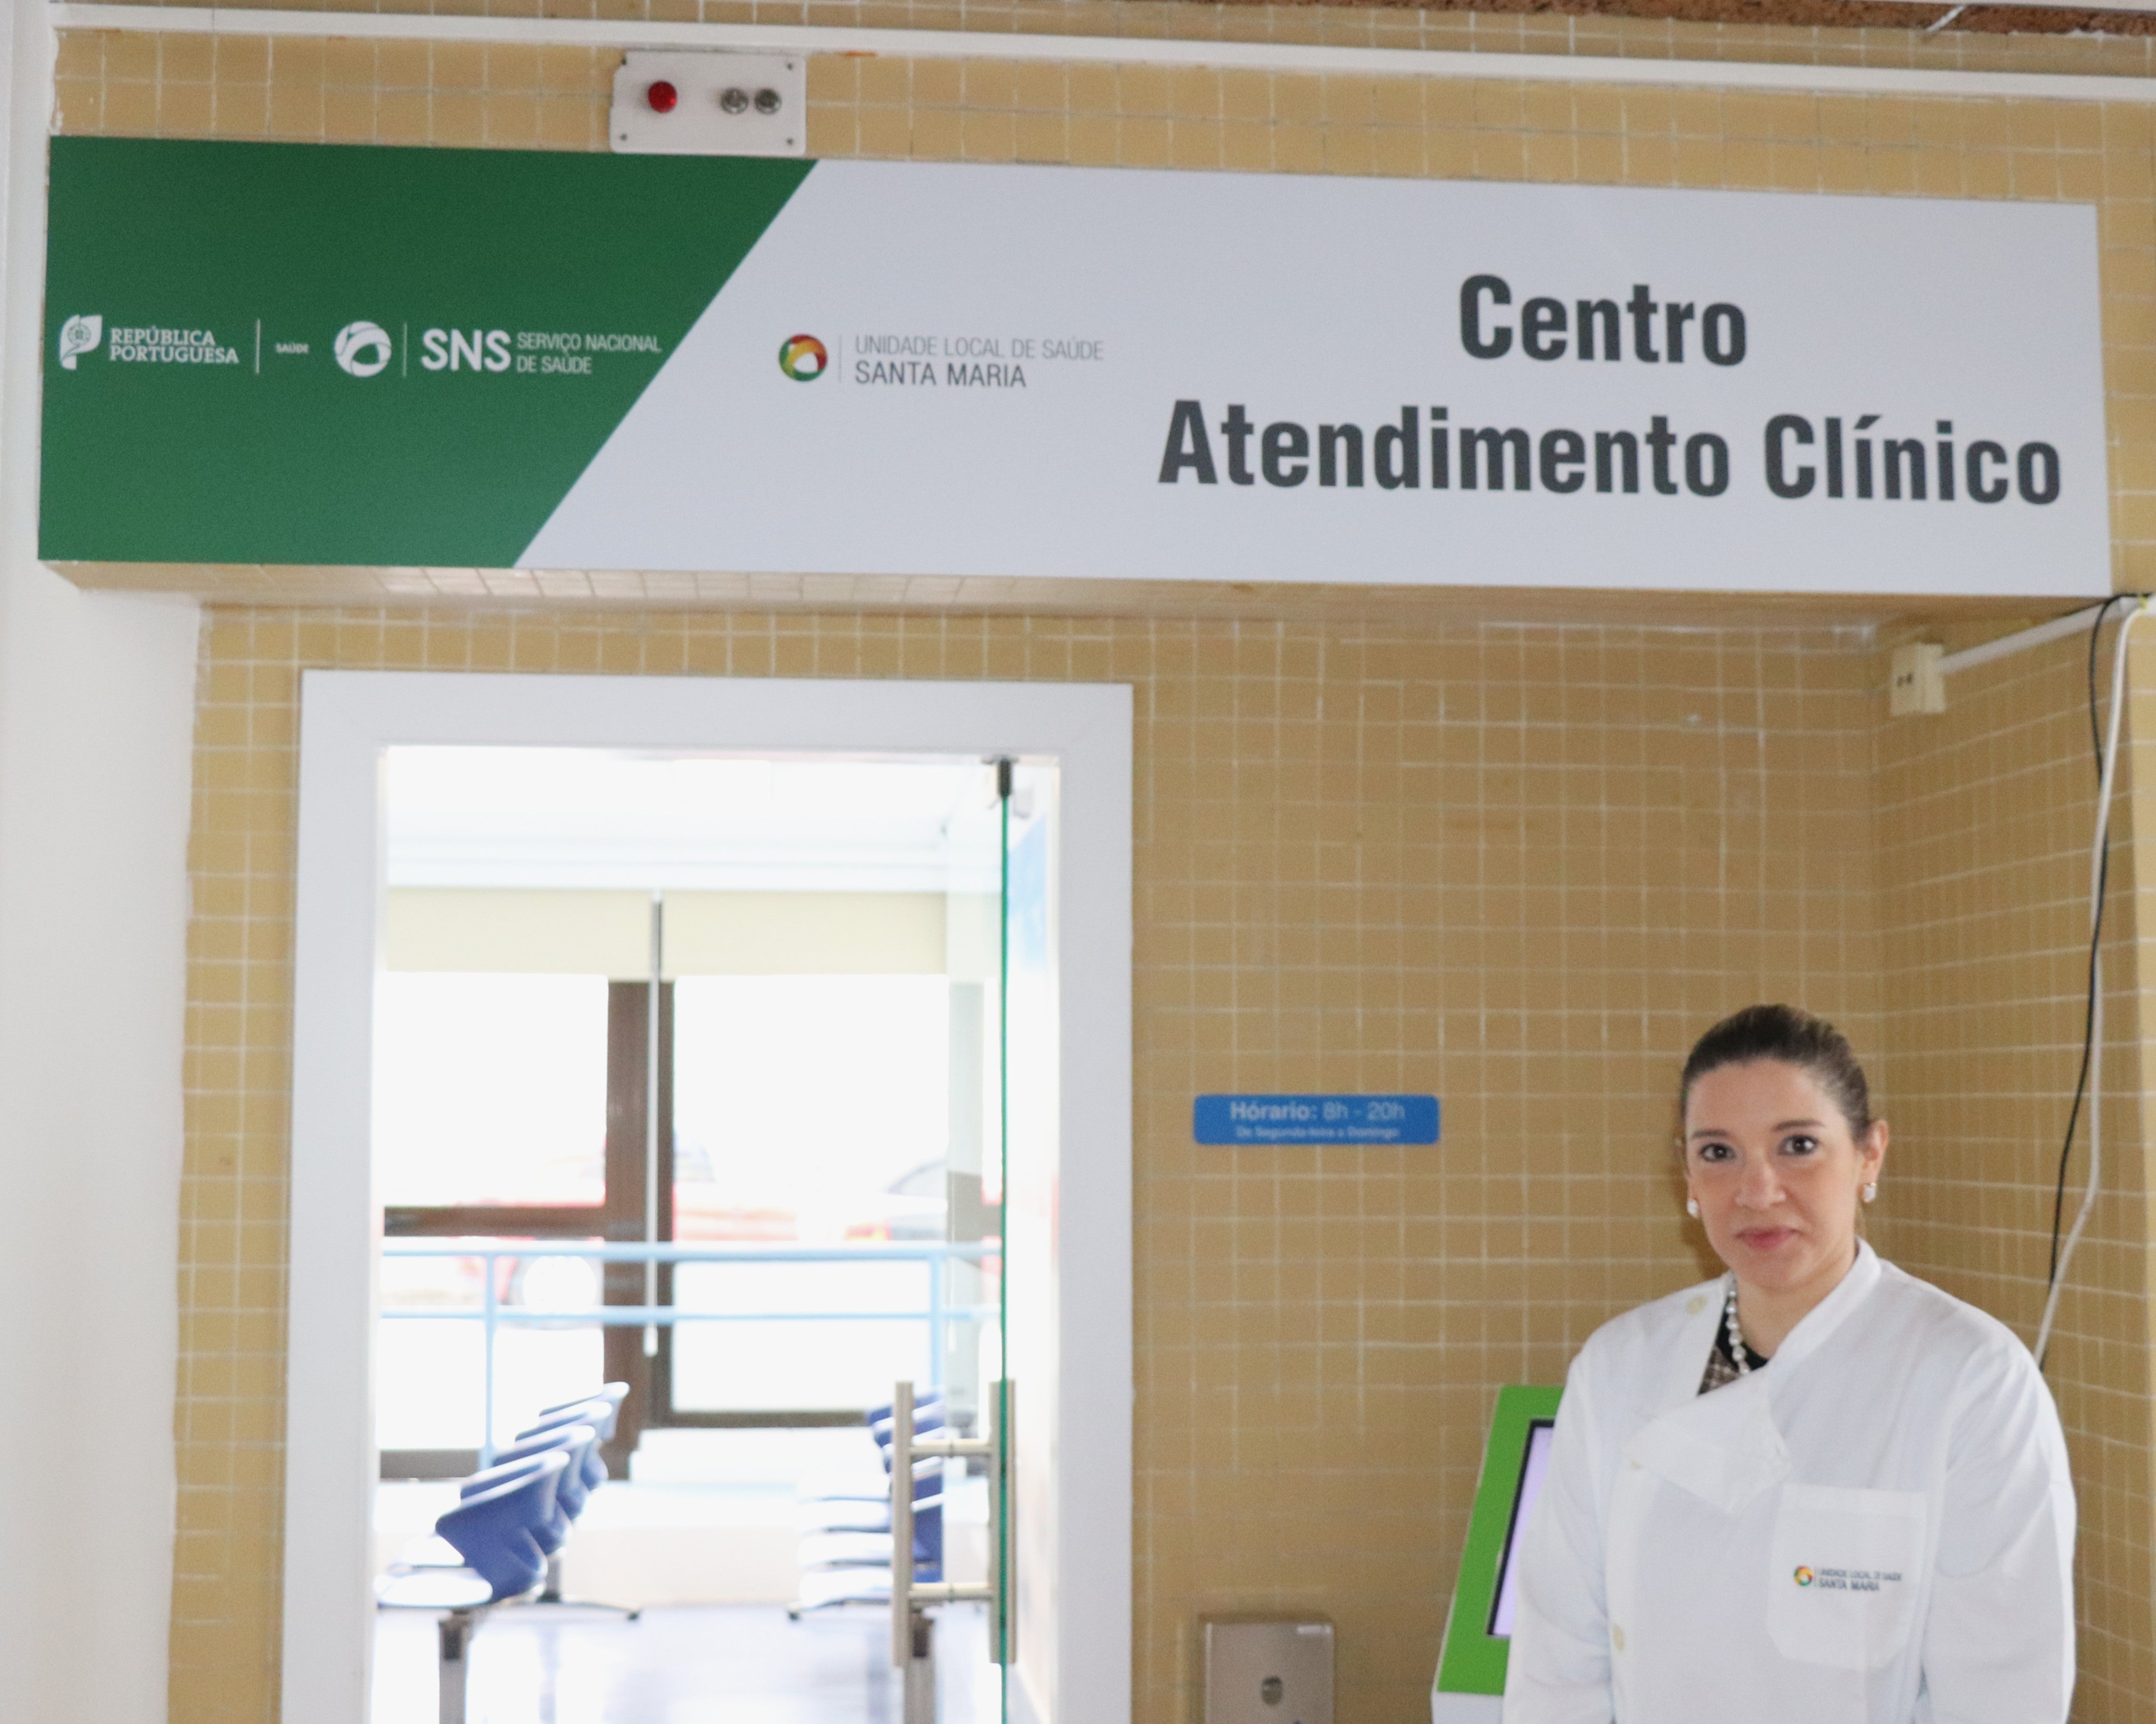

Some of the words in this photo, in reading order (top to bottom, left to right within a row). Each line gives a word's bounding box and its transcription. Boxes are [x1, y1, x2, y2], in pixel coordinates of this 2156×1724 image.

[1459, 274, 1747, 366] Centro
[110, 326, 216, 346] REPÚBLICA
[517, 332, 581, 354] SERVIÇO
[586, 334, 662, 352] NACIONAL
[856, 335, 938, 356] UNIDADE
[944, 337, 1003, 358] LOCAL
[1011, 339, 1035, 359] DE
[1042, 336, 1104, 361] SAÚDE
[110, 345, 239, 364] PORTUGUESA
[422, 328, 512, 372] SNS
[517, 356, 537, 373] DE
[542, 352, 592, 375] SAÚDE
[855, 360, 937, 386] SANTA
[947, 363, 1027, 388] MARIA
[1157, 399, 1730, 497] Atendimento
[1763, 414, 2062, 505] Clínico
[1323, 1101, 1349, 1120] 8h
[1367, 1101, 1406, 1120] 20h
